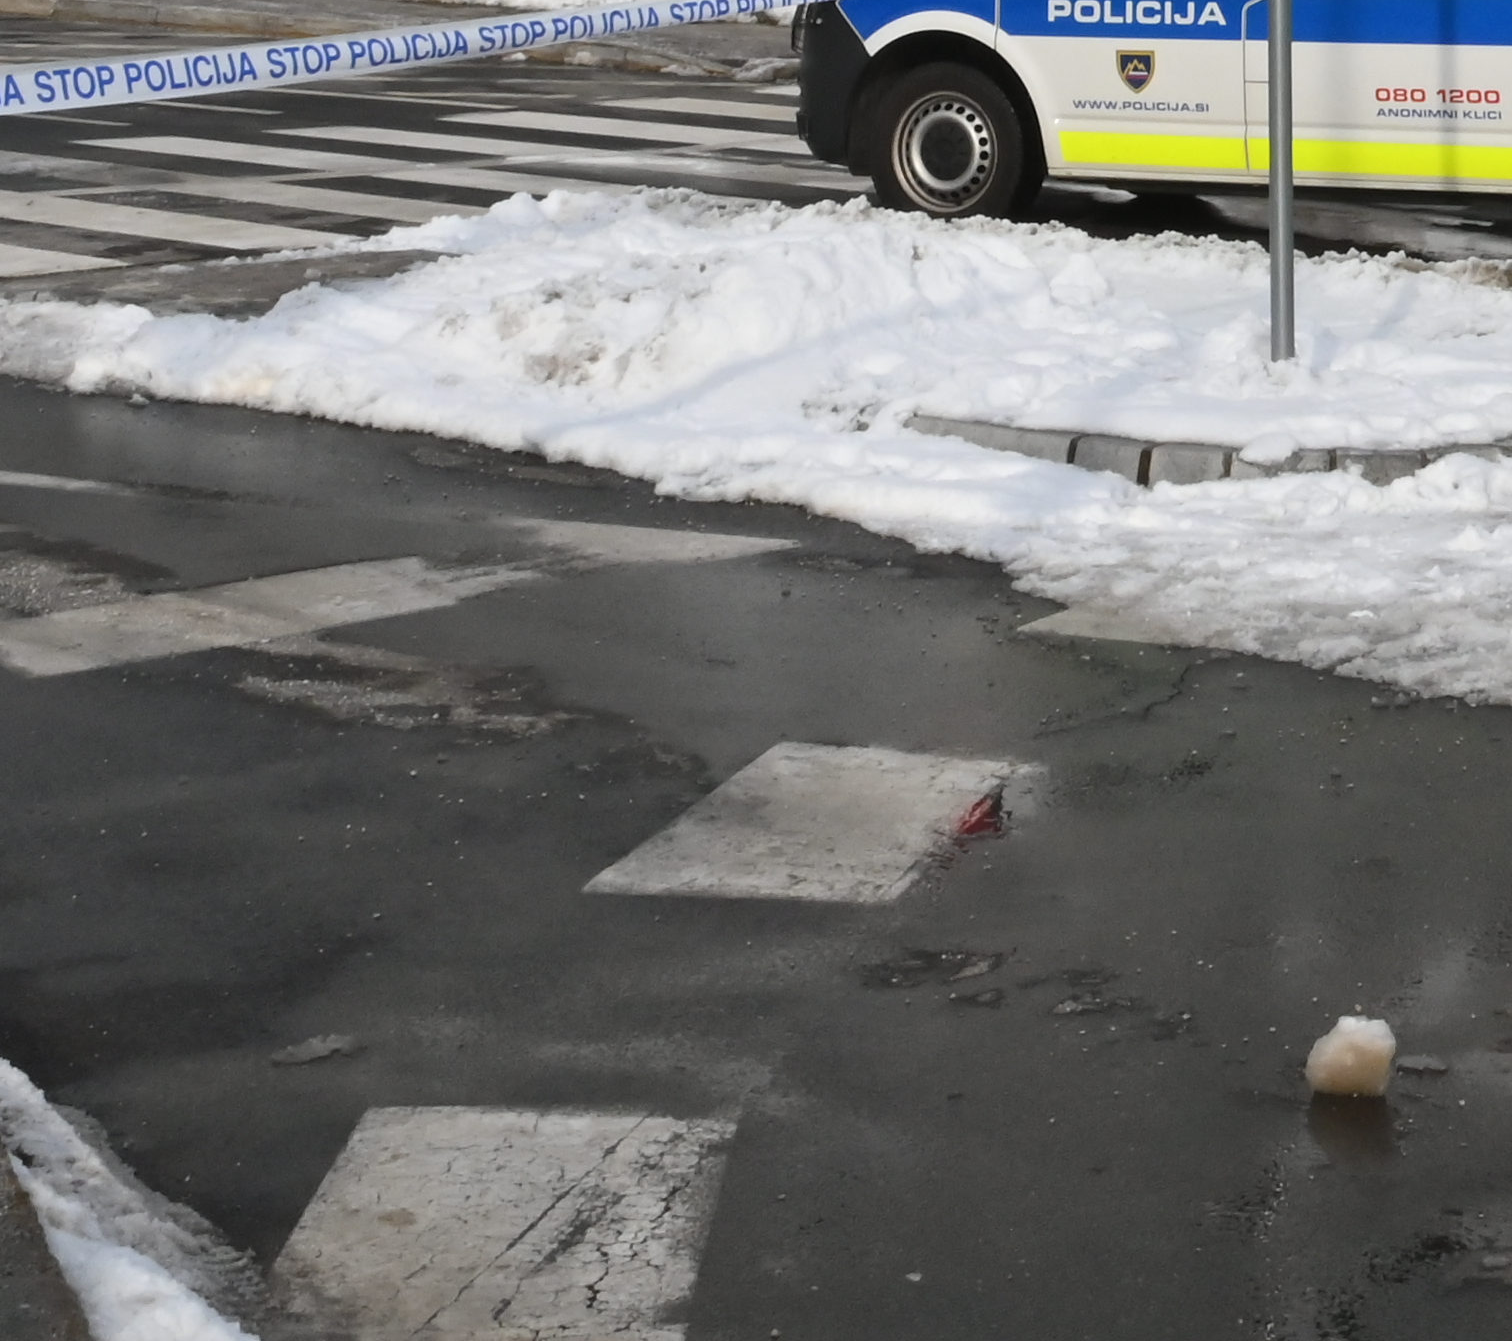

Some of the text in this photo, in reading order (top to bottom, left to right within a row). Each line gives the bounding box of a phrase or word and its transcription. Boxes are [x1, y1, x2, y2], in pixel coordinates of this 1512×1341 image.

[34, 64, 116, 103] STOP
[125, 51, 257, 94] POLICIJA
[267, 44, 341, 79] STOP
[350, 30, 468, 70] POLICIJA
[479, 20, 546, 53] STOP
[553, 7, 659, 42] POLICIJA
[1375, 88, 1500, 104] 080 1200
[1073, 99, 1209, 113] WWW.POLICIJA.SI
[1377, 108, 1502, 120] ANONIMNI KLICI
